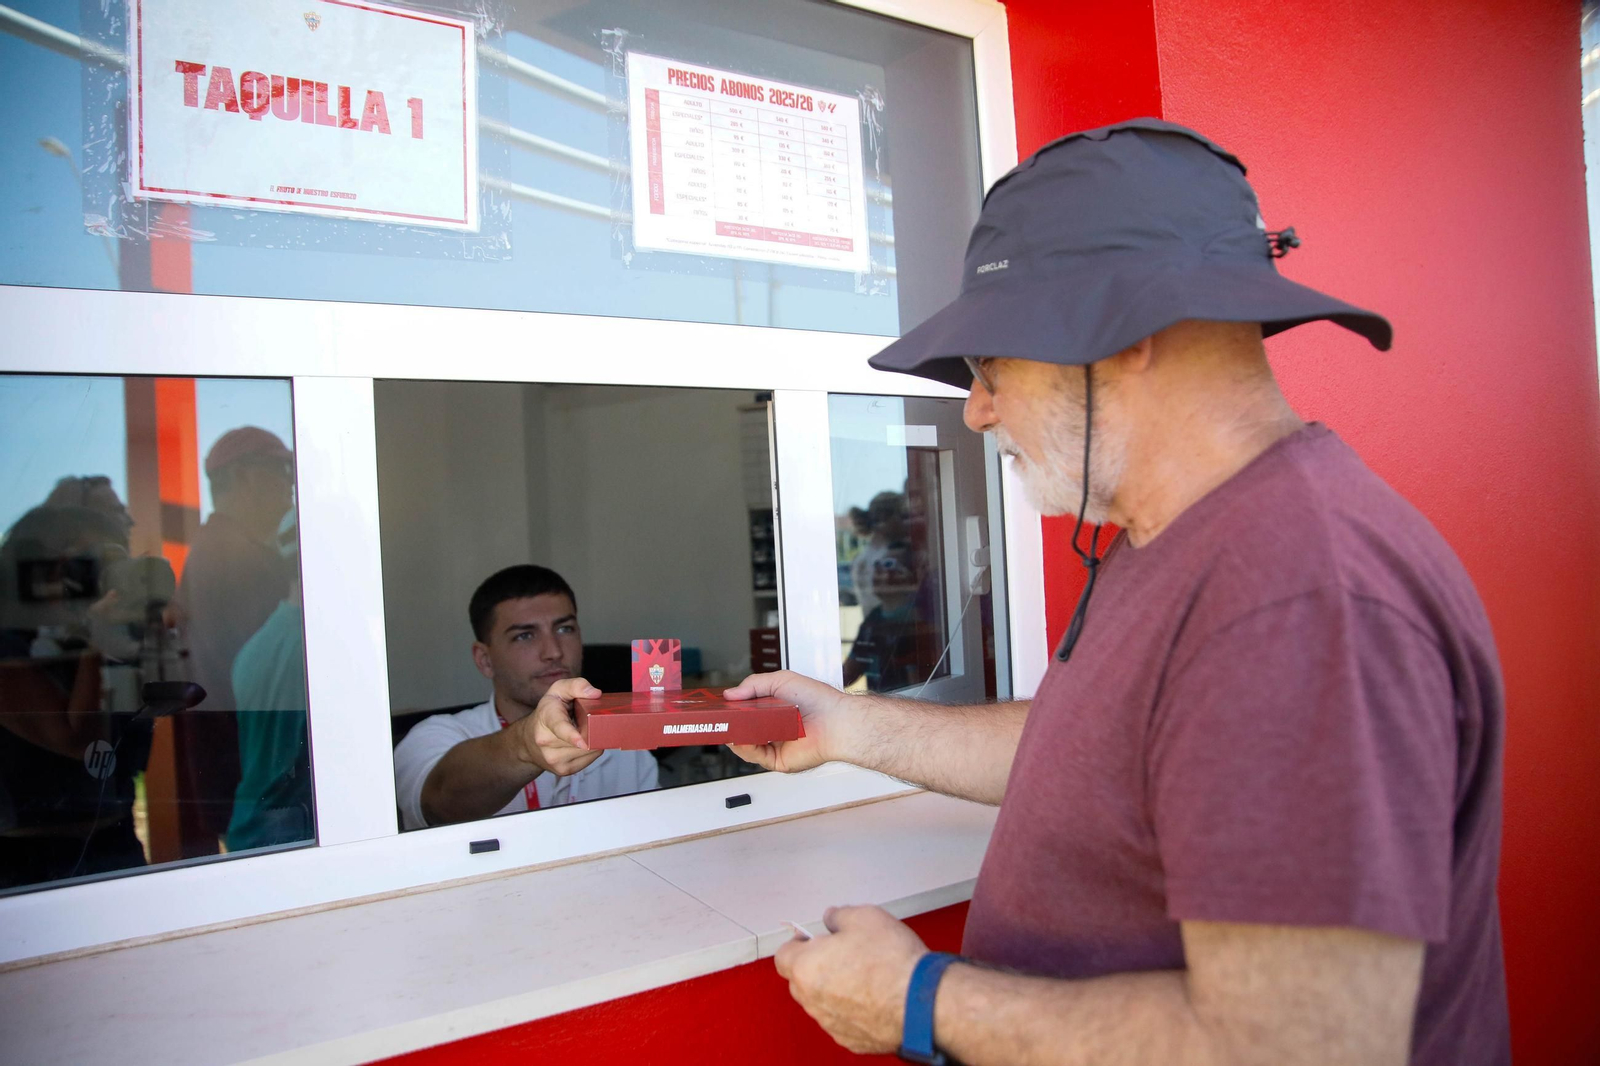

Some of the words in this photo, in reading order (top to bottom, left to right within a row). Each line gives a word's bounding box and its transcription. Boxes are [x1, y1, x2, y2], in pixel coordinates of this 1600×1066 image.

[668, 67, 715, 93] PRECIOS
[720, 78, 764, 102] ABONOS
[768, 88, 814, 113] 2025/26
[175, 60, 391, 134] TAQUILLA
[407, 97, 423, 140] 1
[684, 99, 702, 108] ADULTO
[685, 140, 704, 148] ADULTO
[276, 186, 296, 194] FRUTO
[303, 188, 329, 198] NUESTRO
[330, 191, 357, 200] ESFUERZO
[976, 259, 1009, 274] FORCLAZ
[663, 722, 729, 735] UDALMERIASAD.COM
[87, 740, 114, 780] hp
